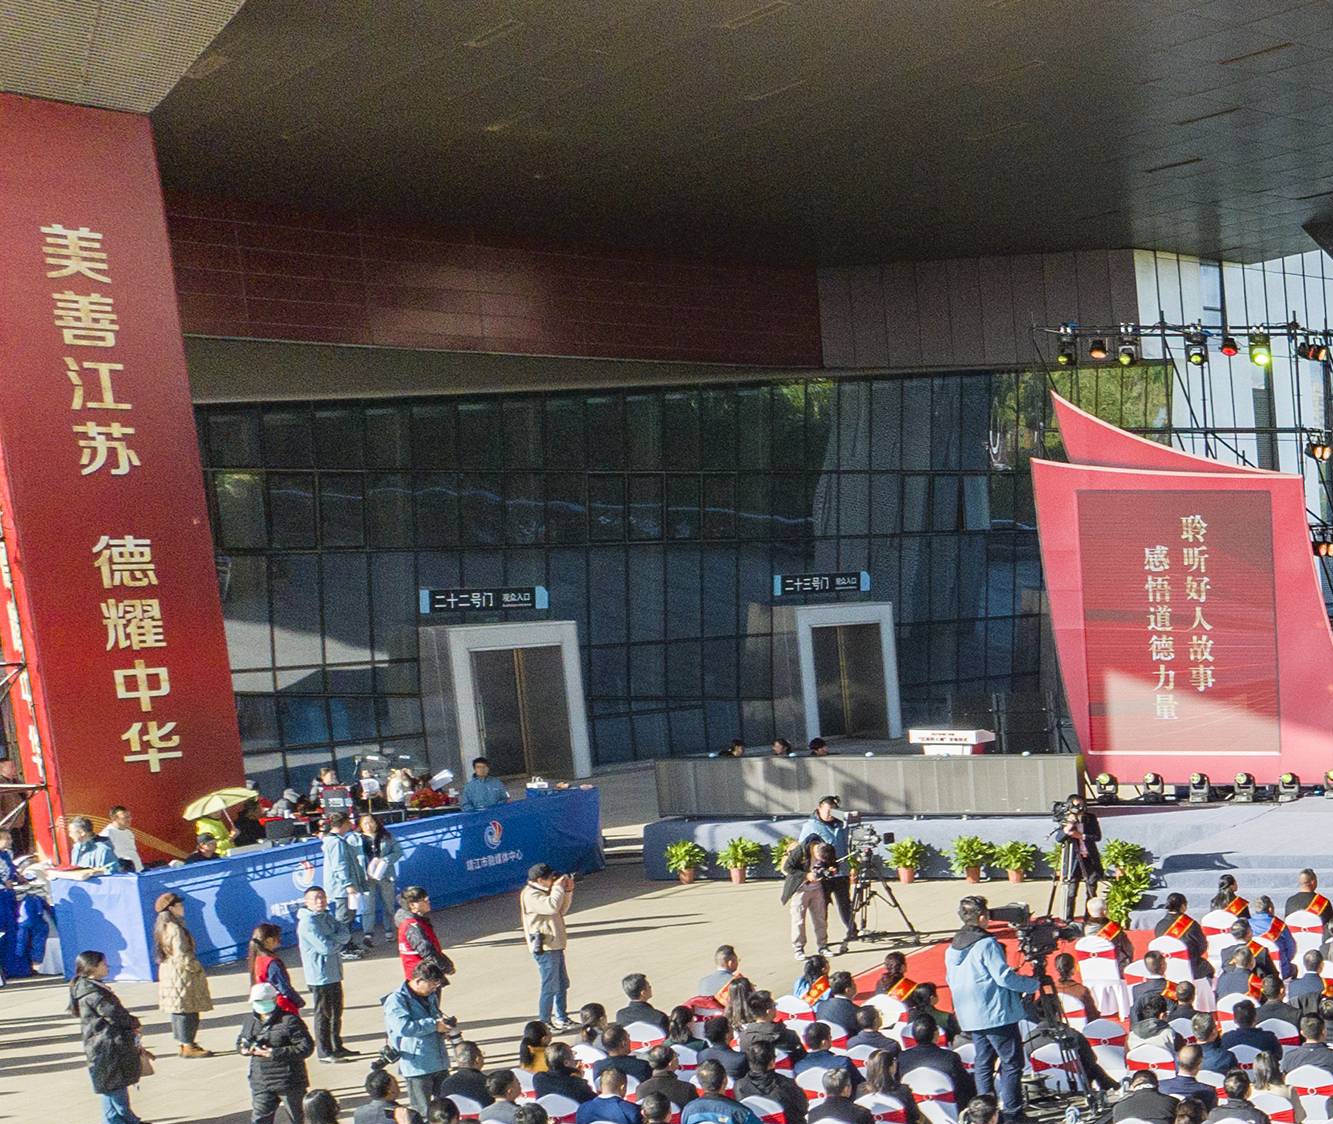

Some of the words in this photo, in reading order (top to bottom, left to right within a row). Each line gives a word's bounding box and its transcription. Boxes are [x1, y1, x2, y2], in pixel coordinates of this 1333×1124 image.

[39, 223, 141, 478] 美善江苏
[92, 534, 184, 774] 德耀中华
[784, 576, 830, 592] 二十三号门
[434, 592, 494, 609] 二十二号门
[1143, 545, 1178, 721] 感悟道德力量
[1180, 514, 1216, 693] 聆听好人故事
